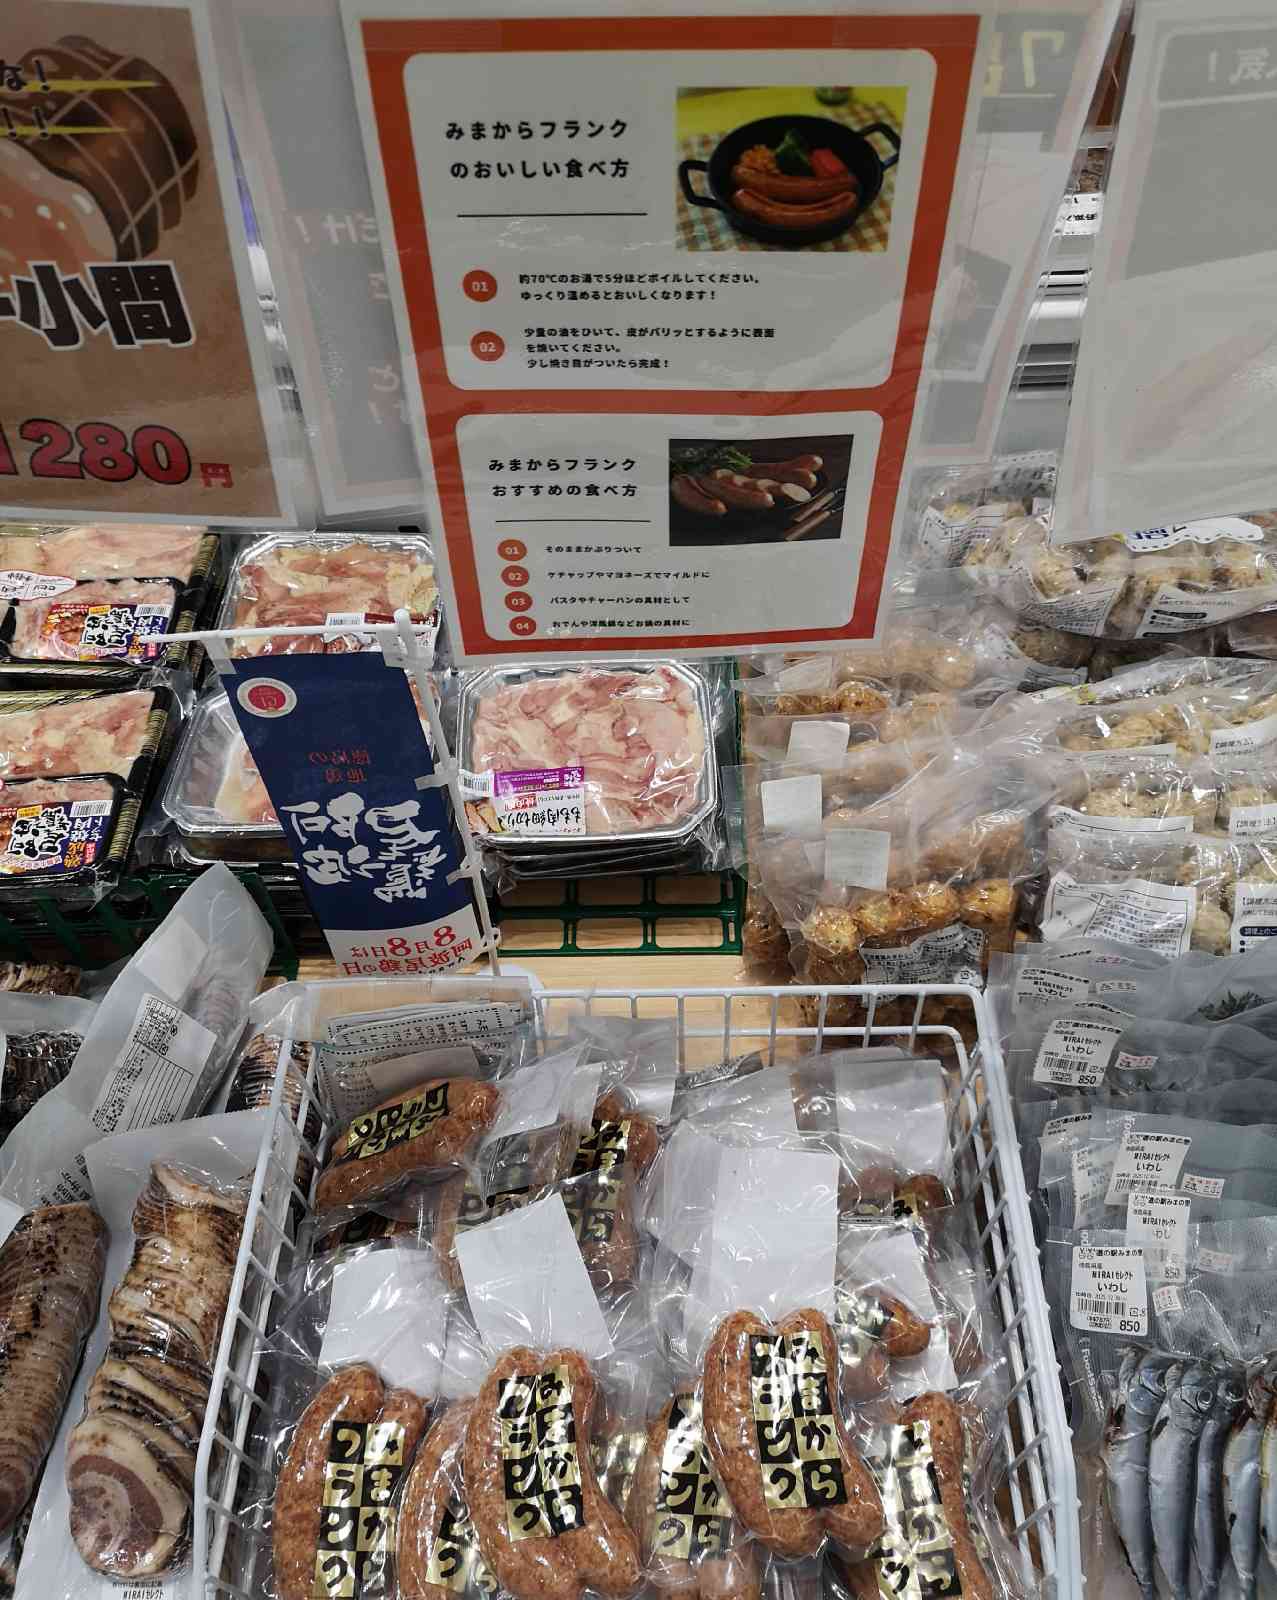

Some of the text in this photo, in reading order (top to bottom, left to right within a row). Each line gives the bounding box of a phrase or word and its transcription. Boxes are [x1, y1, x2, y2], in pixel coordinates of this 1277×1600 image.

[446, 119, 627, 140] みまからフランク
[450, 158, 629, 179] のおいしい食べ方
[471, 281, 490, 292] 01
[0, 261, 195, 350] 小間
[479, 342, 497, 353] 02
[488, 458, 637, 472] みまからフランク
[491, 483, 638, 497] おすすめの食べ方
[1065, 1045, 1095, 1055] いわし
[1078, 1074, 1097, 1085] 850
[1136, 1162, 1162, 1171] いわし
[1097, 1281, 1128, 1293] いわし
[1119, 1319, 1141, 1333] 850
[539, 1372, 578, 1526] みまから
[322, 1427, 361, 1590] フランク
